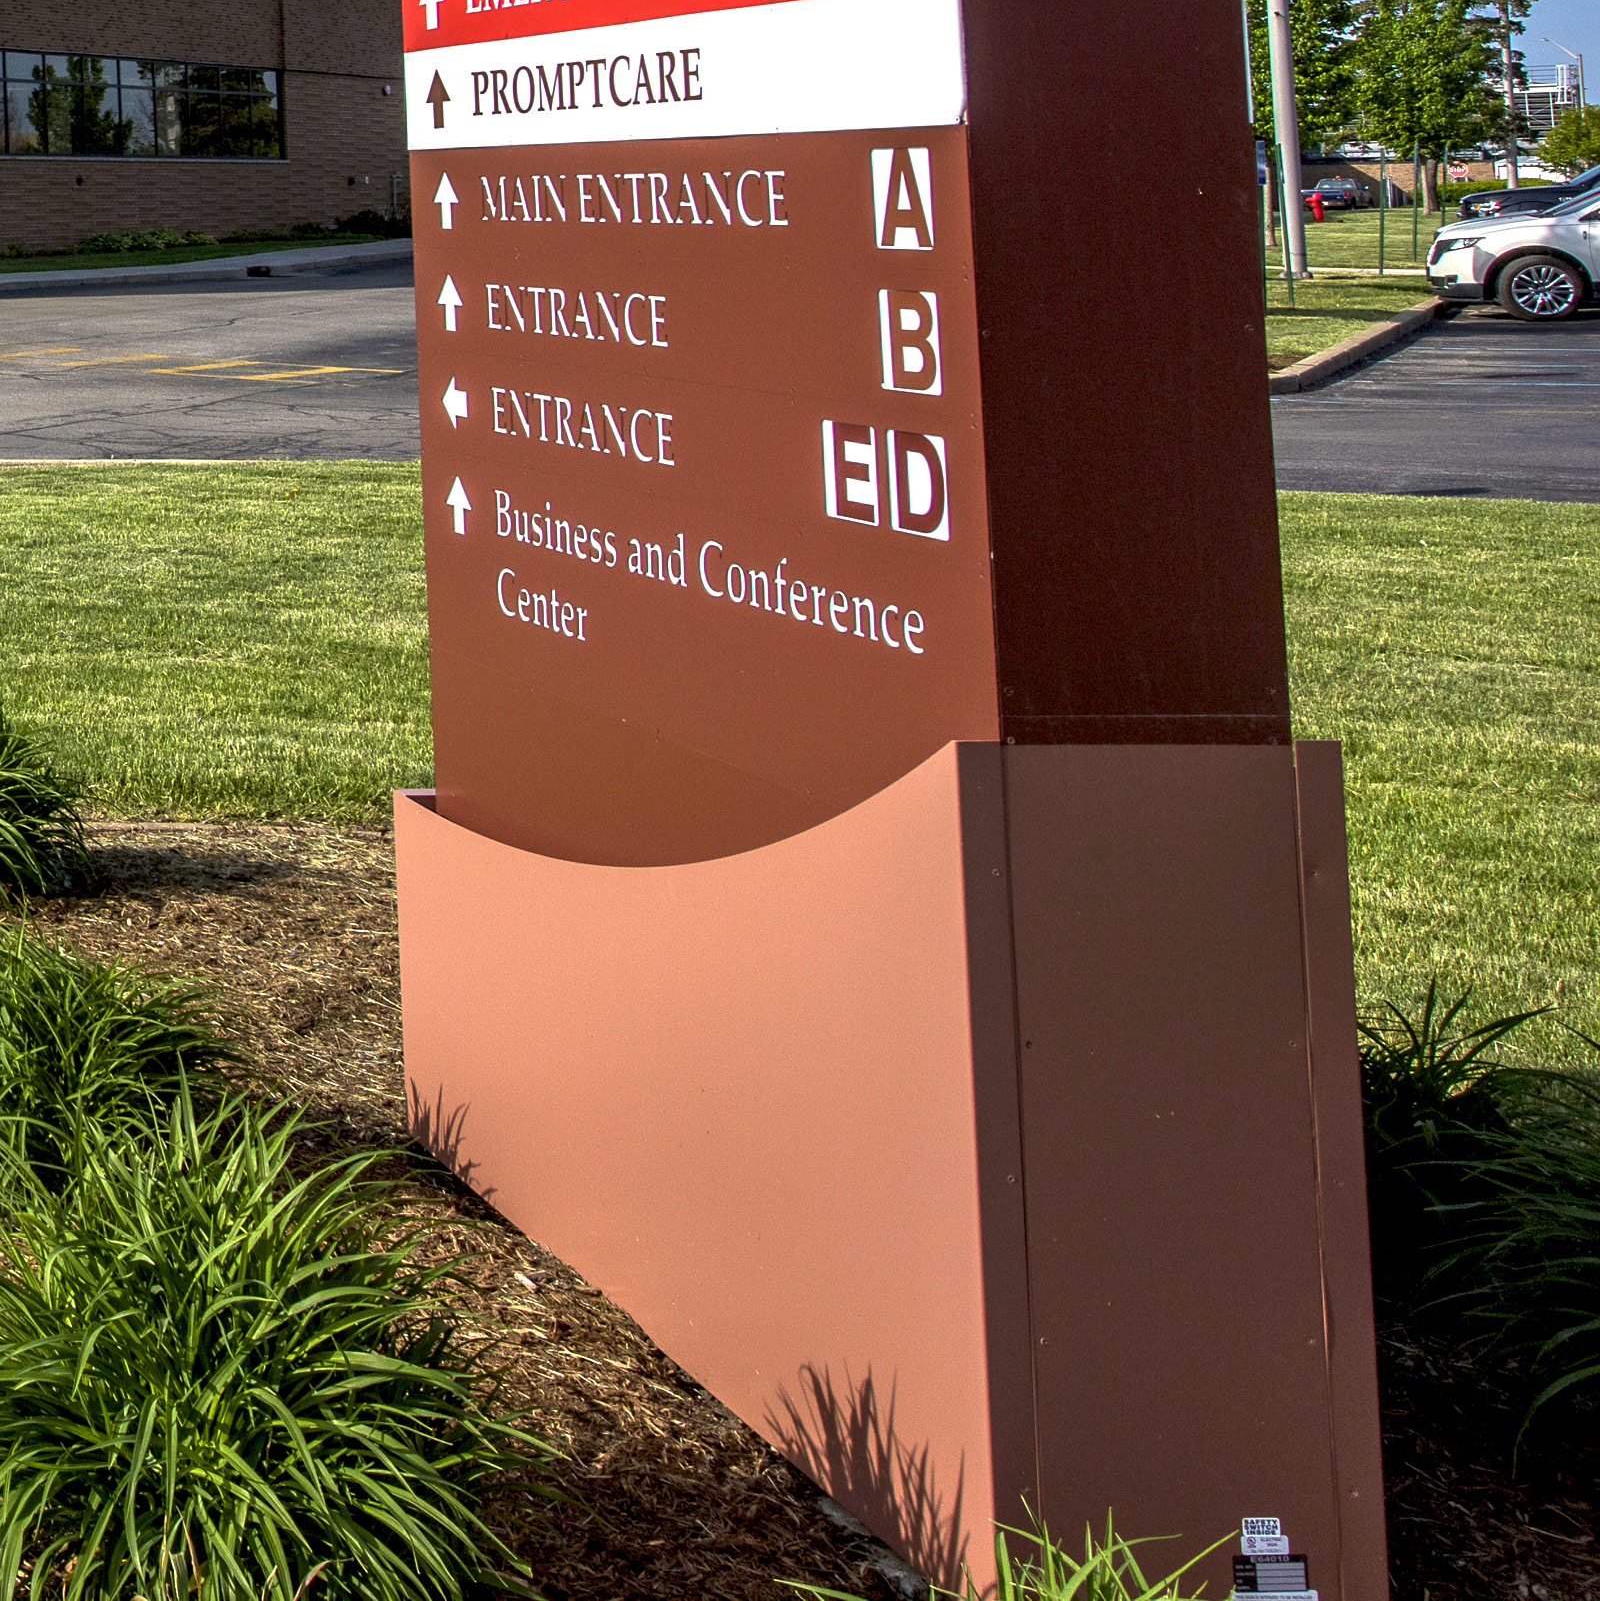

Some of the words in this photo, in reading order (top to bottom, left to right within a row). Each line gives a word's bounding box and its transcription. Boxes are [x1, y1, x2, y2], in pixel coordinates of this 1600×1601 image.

[471, 48, 703, 116] PROMPTCARE
[481, 174, 566, 222] MAIN
[579, 170, 789, 226] ENTRANCE
[873, 148, 934, 249] A
[485, 284, 669, 347] ENTRANCE
[881, 289, 940, 393] B
[490, 387, 675, 467] ENTRANCE
[825, 420, 949, 540] ED
[494, 489, 617, 568] Business
[628, 533, 688, 588] and
[699, 539, 924, 654] Conference
[497, 568, 588, 641] Center
